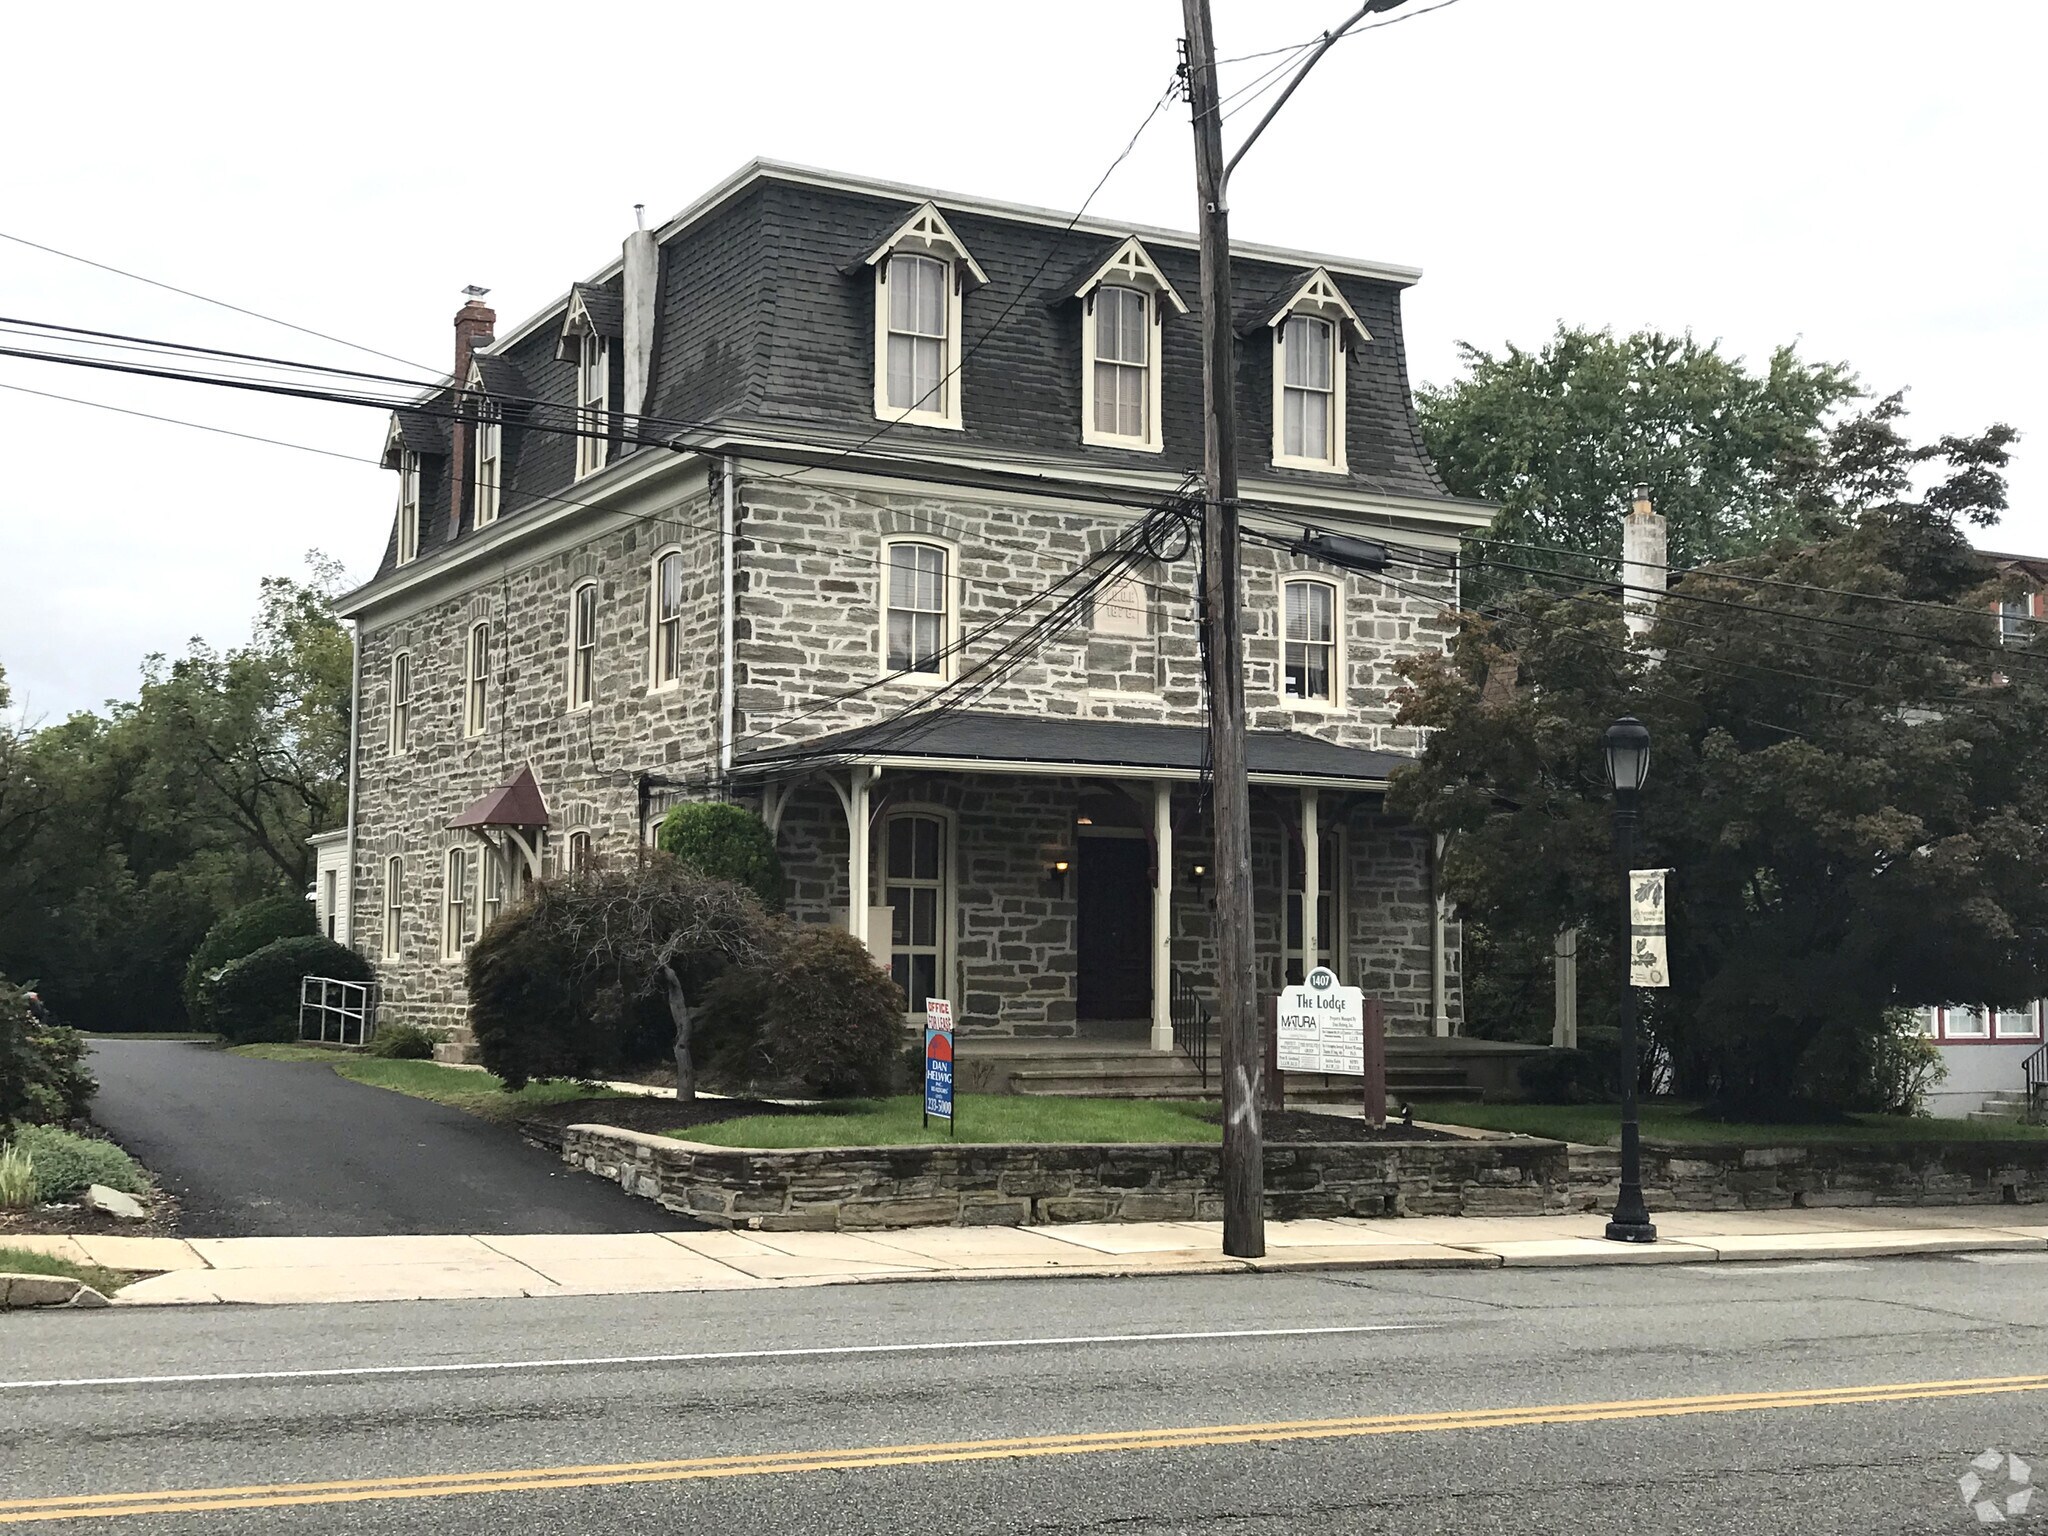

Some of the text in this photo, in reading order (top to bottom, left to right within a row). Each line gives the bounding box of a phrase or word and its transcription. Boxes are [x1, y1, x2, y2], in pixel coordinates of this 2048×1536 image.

[1312, 975, 1330, 986] 1407
[928, 1001, 950, 1014] OFFICE
[1317, 994, 1346, 1012] Lodge
[932, 1060, 948, 1072] DAN
[927, 1070, 952, 1084] HELWIG
